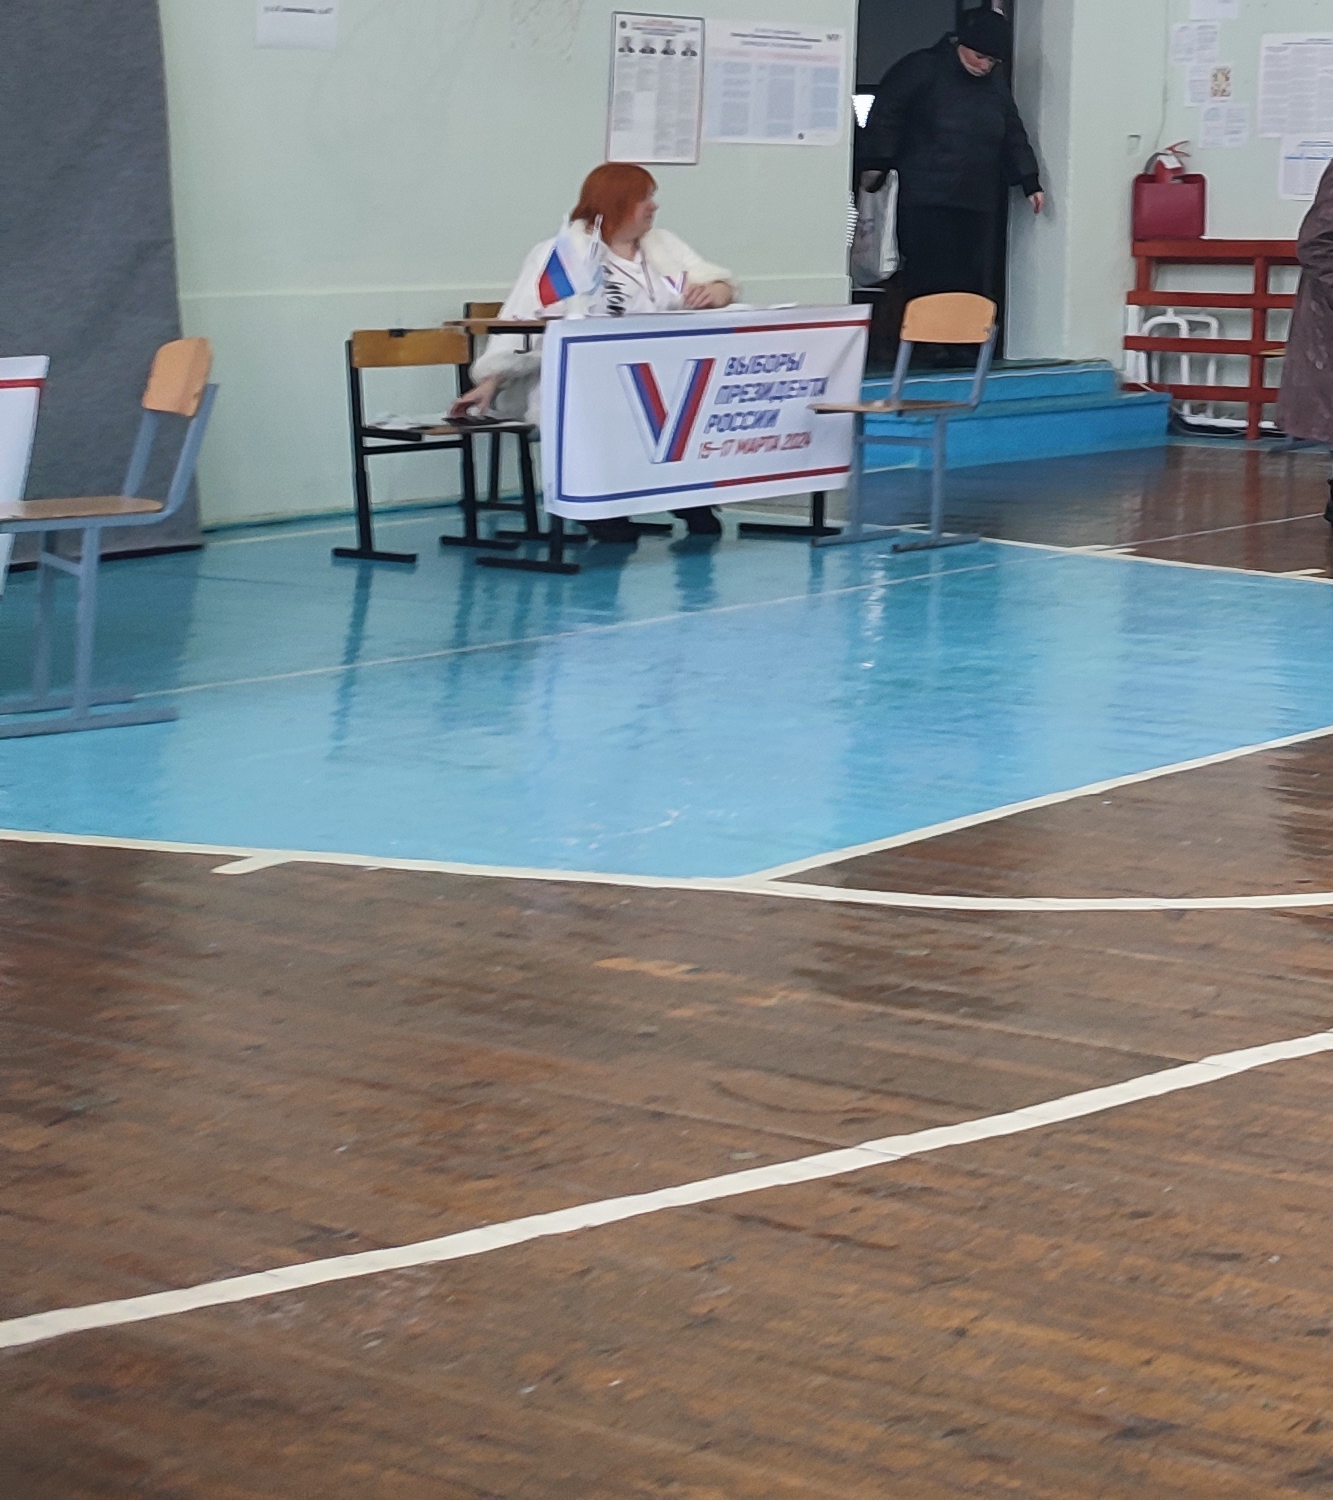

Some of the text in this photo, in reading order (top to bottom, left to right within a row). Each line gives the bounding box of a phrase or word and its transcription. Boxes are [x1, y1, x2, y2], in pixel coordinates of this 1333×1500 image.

[723, 352, 806, 376] ВЫБОРЫ
[714, 377, 829, 405] ПРЕЗИДЕНТА
[703, 409, 781, 434] РОССИИ
